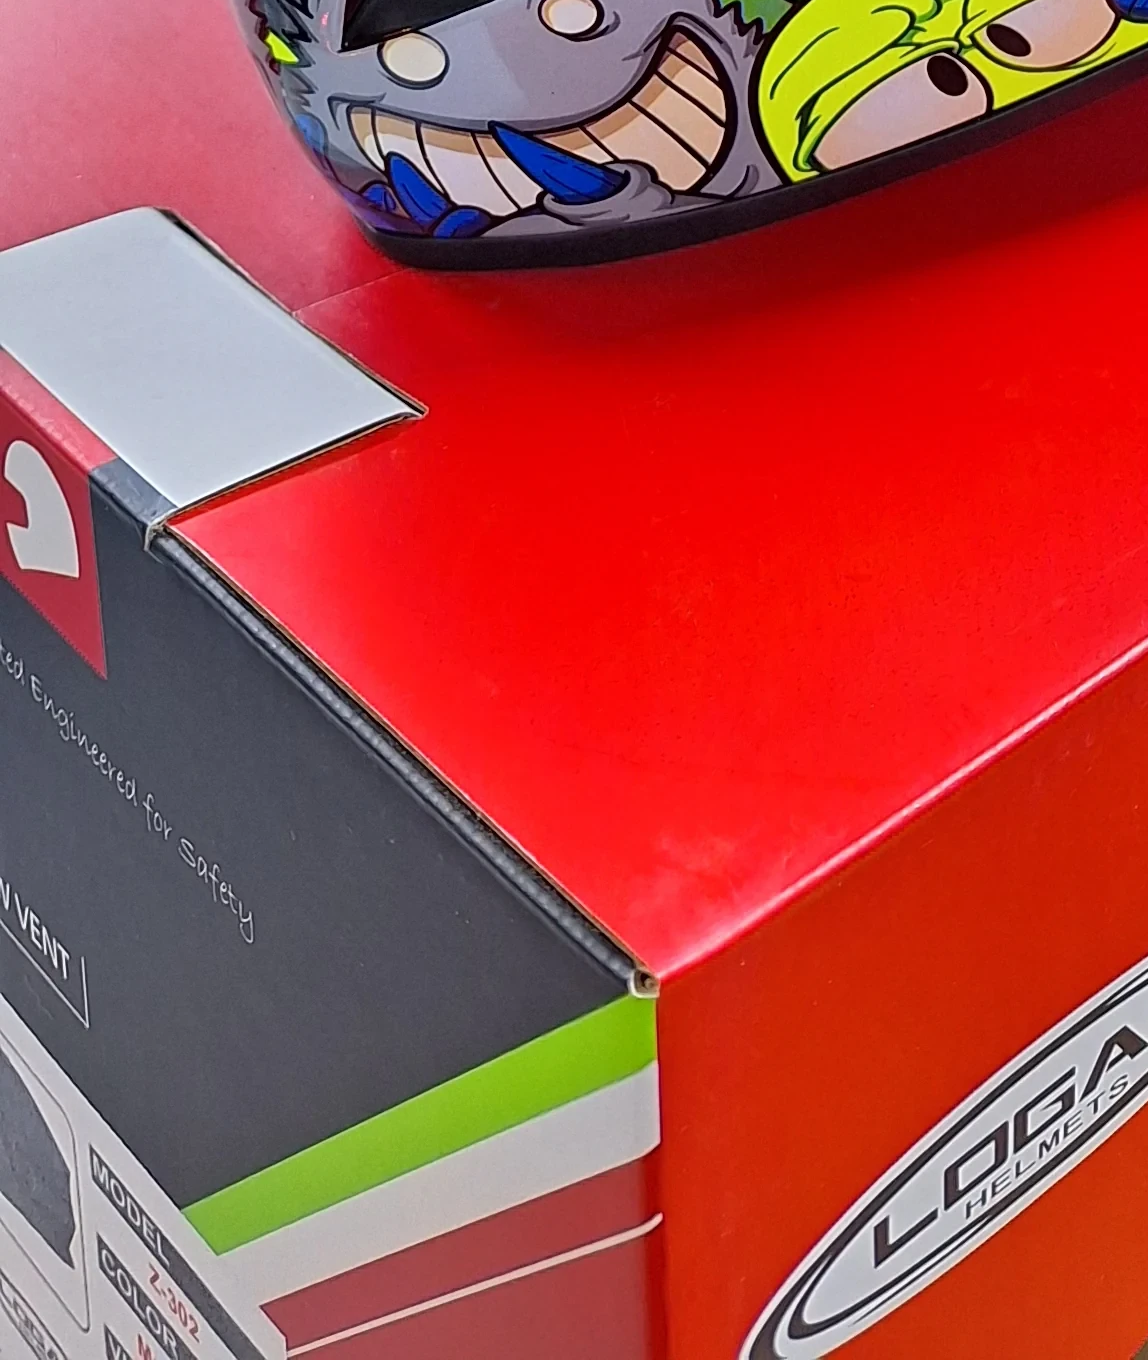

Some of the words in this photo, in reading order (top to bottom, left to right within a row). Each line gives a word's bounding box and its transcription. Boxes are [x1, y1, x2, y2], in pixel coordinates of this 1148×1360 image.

[30, 674, 138, 807] Engineered
[143, 792, 173, 840] for
[14, 892, 70, 980] VENT
[965, 1074, 1129, 1220] HELMETS
[92, 1157, 171, 1268] MODEL
[102, 1248, 178, 1360] COLOR
[149, 1261, 200, 1344] Z-302
